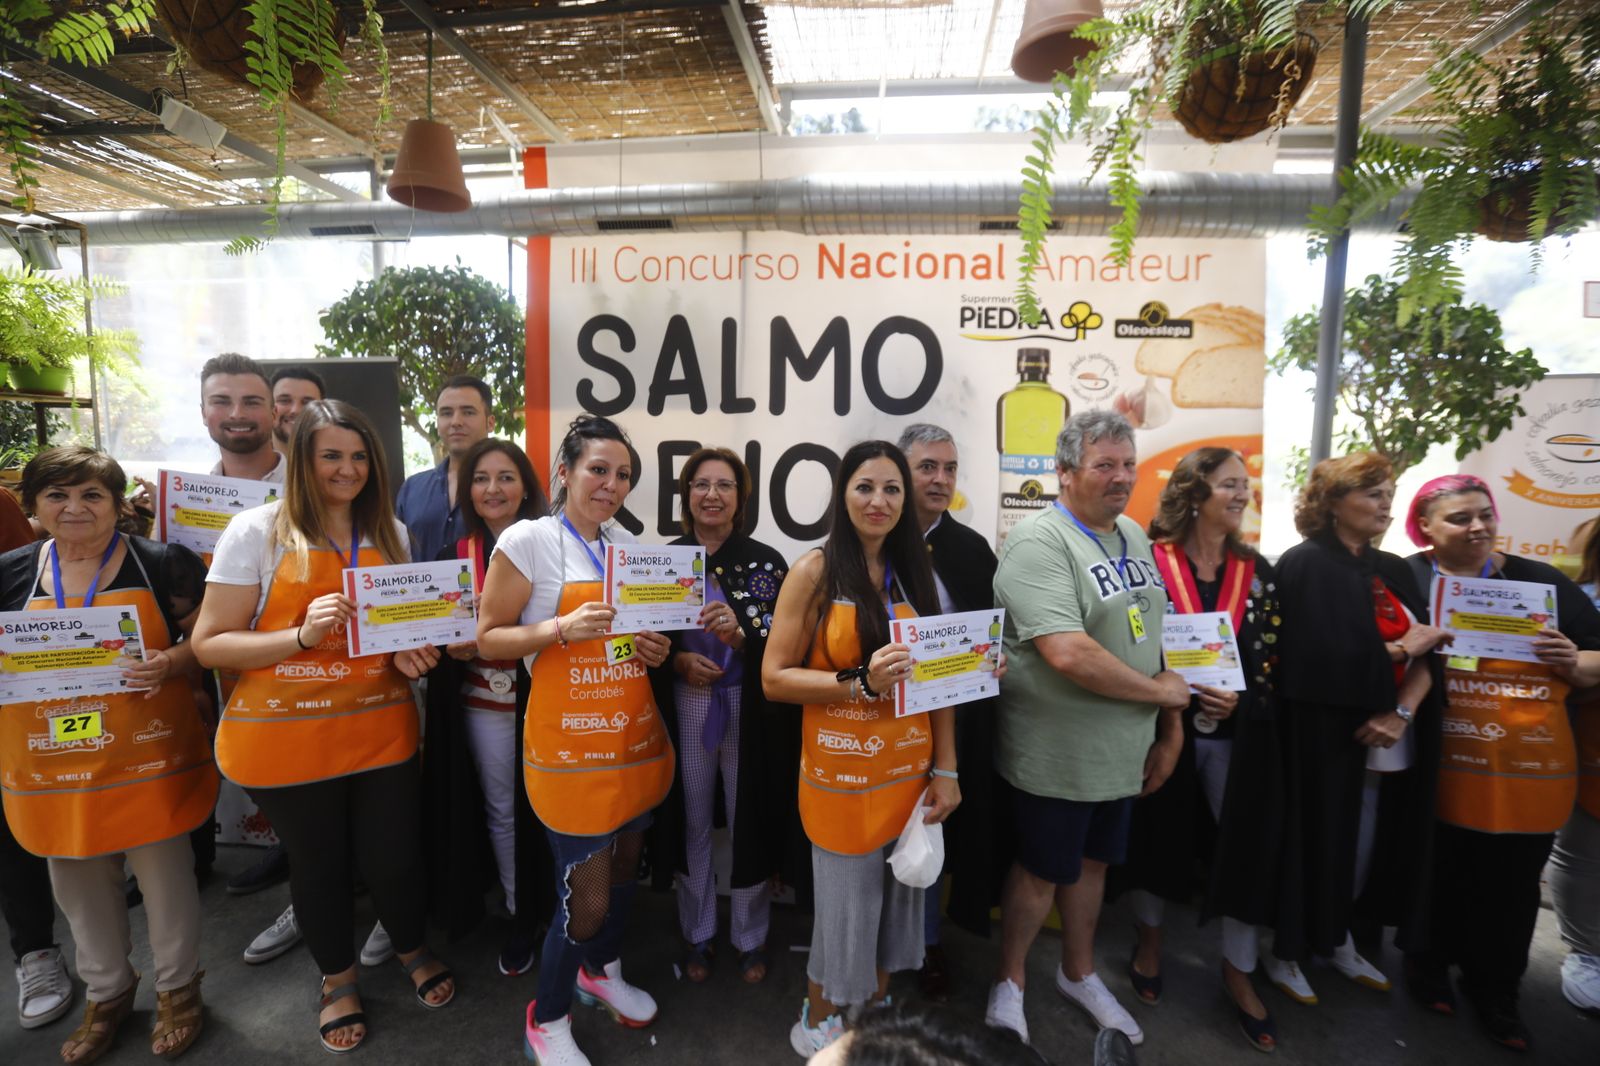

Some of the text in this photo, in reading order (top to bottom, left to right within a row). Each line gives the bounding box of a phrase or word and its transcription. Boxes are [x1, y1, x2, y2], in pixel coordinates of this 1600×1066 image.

[571, 241, 1213, 283] III Concurso Nacional Amateur
[1117, 324, 1191, 337] Oleoestepa
[576, 313, 944, 417] SALMO
[173, 476, 183, 491] 3
[183, 482, 239, 497] SALMOREJO
[618, 550, 627, 567] 3
[626, 555, 672, 566] SALMOREJO
[362, 573, 374, 590] 3
[374, 574, 432, 588] SALMOREJO
[1450, 581, 1462, 597] 3
[1462, 587, 1520, 601] SALMOREJO
[4, 620, 83, 634] SALMOREJO
[907, 625, 919, 643] 3
[919, 624, 967, 641] SALMOREJO
[1163, 624, 1194, 633] MOREJO
[614, 643, 632, 659] 23
[275, 664, 327, 677] PIEDRA
[570, 662, 648, 684] SALMOREJ
[570, 685, 625, 700] Cordobés
[1447, 678, 1551, 701] ALMOREJO
[826, 703, 880, 721] Cordobés
[62, 715, 92, 733] 27
[562, 717, 609, 730] PIEDRA
[818, 733, 863, 752] PIEDRA
